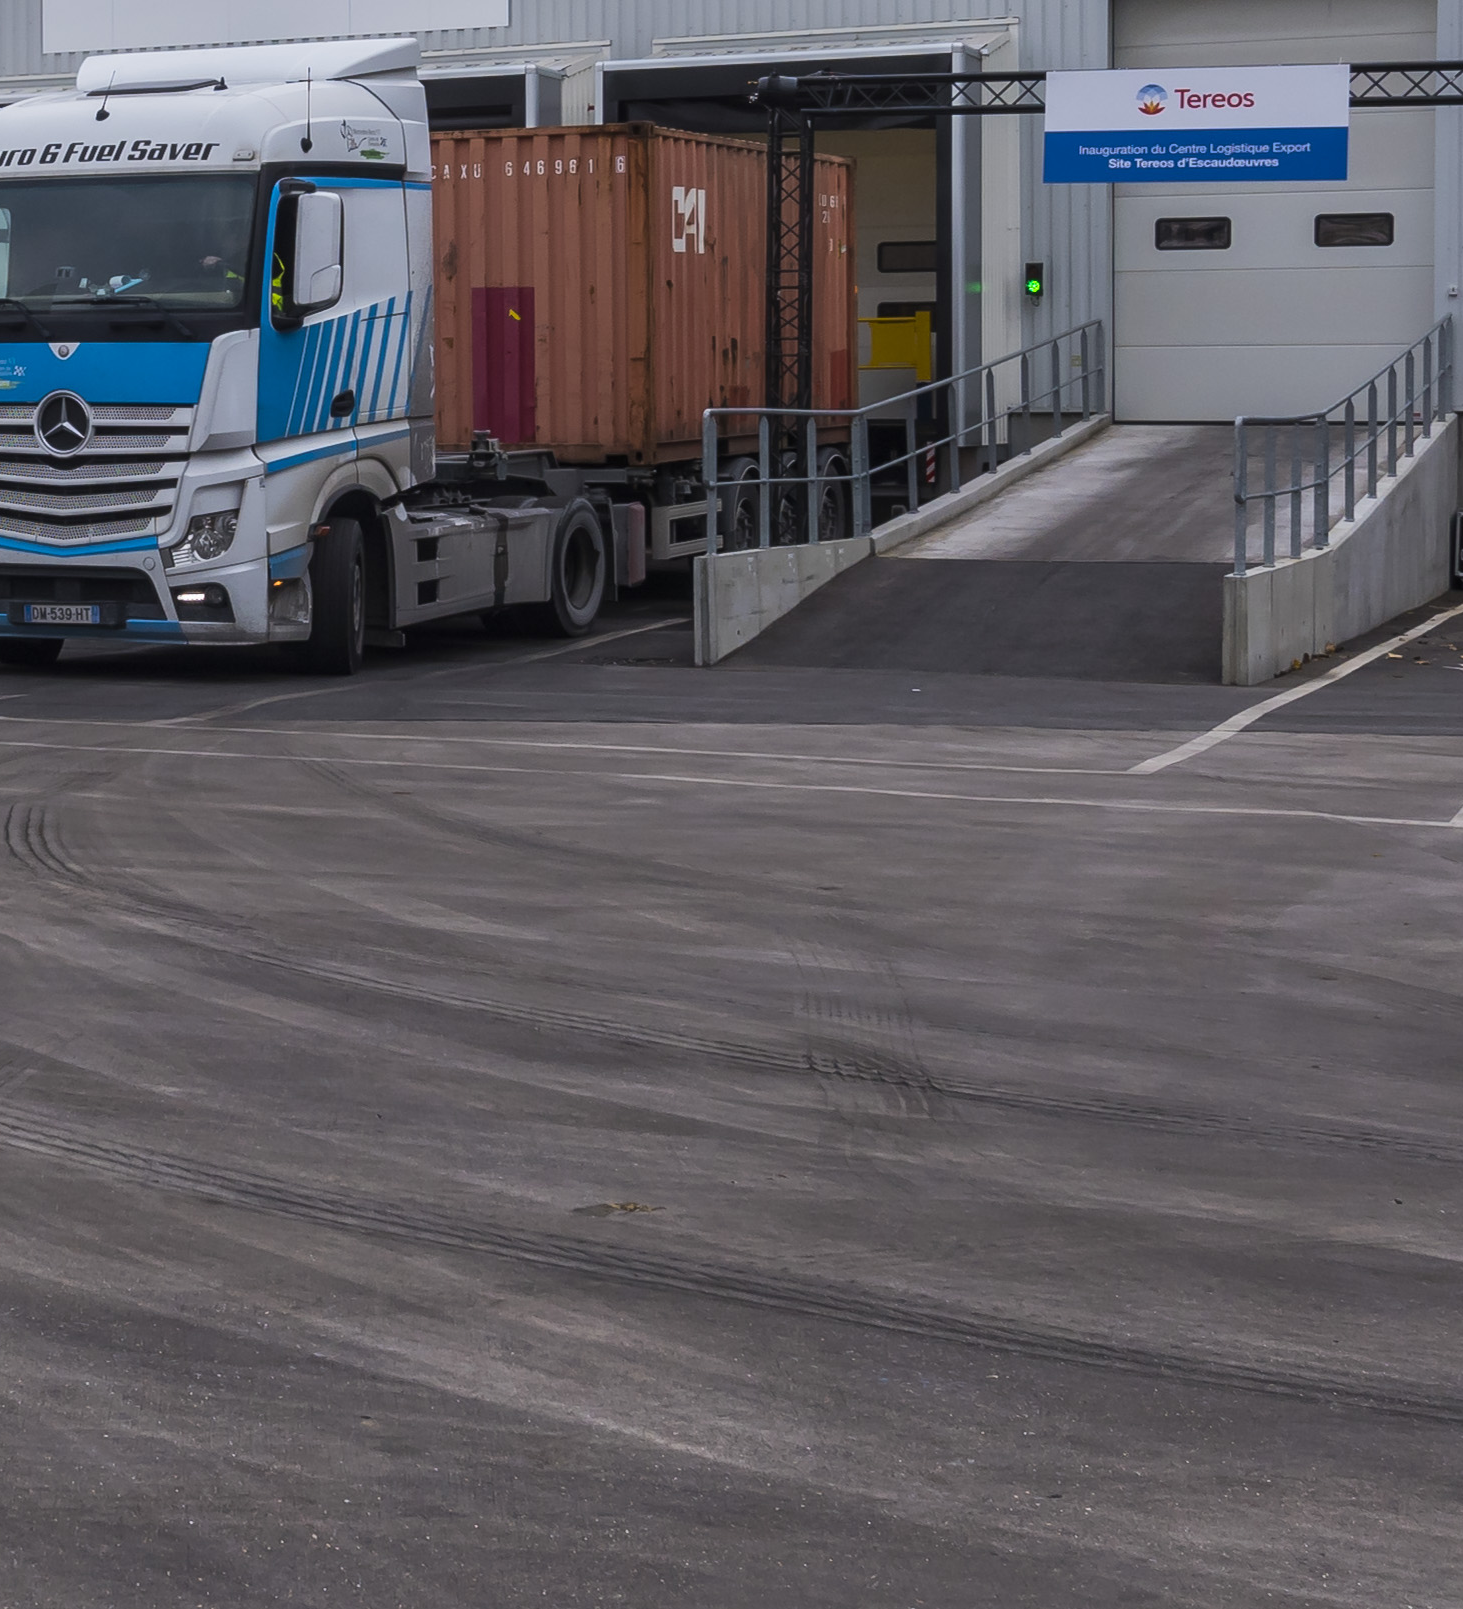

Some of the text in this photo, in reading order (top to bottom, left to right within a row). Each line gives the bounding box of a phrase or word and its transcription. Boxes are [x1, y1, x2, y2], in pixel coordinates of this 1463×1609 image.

[1174, 88, 1255, 109] Tereos
[39, 143, 63, 165] 6
[62, 140, 127, 163] Fuel
[127, 139, 220, 161] Saver
[1078, 142, 1311, 157] Inauguration du Centre Logistique Export
[615, 156, 626, 174] 6
[1108, 158, 1132, 169] Site
[1134, 158, 1175, 169] Tereos
